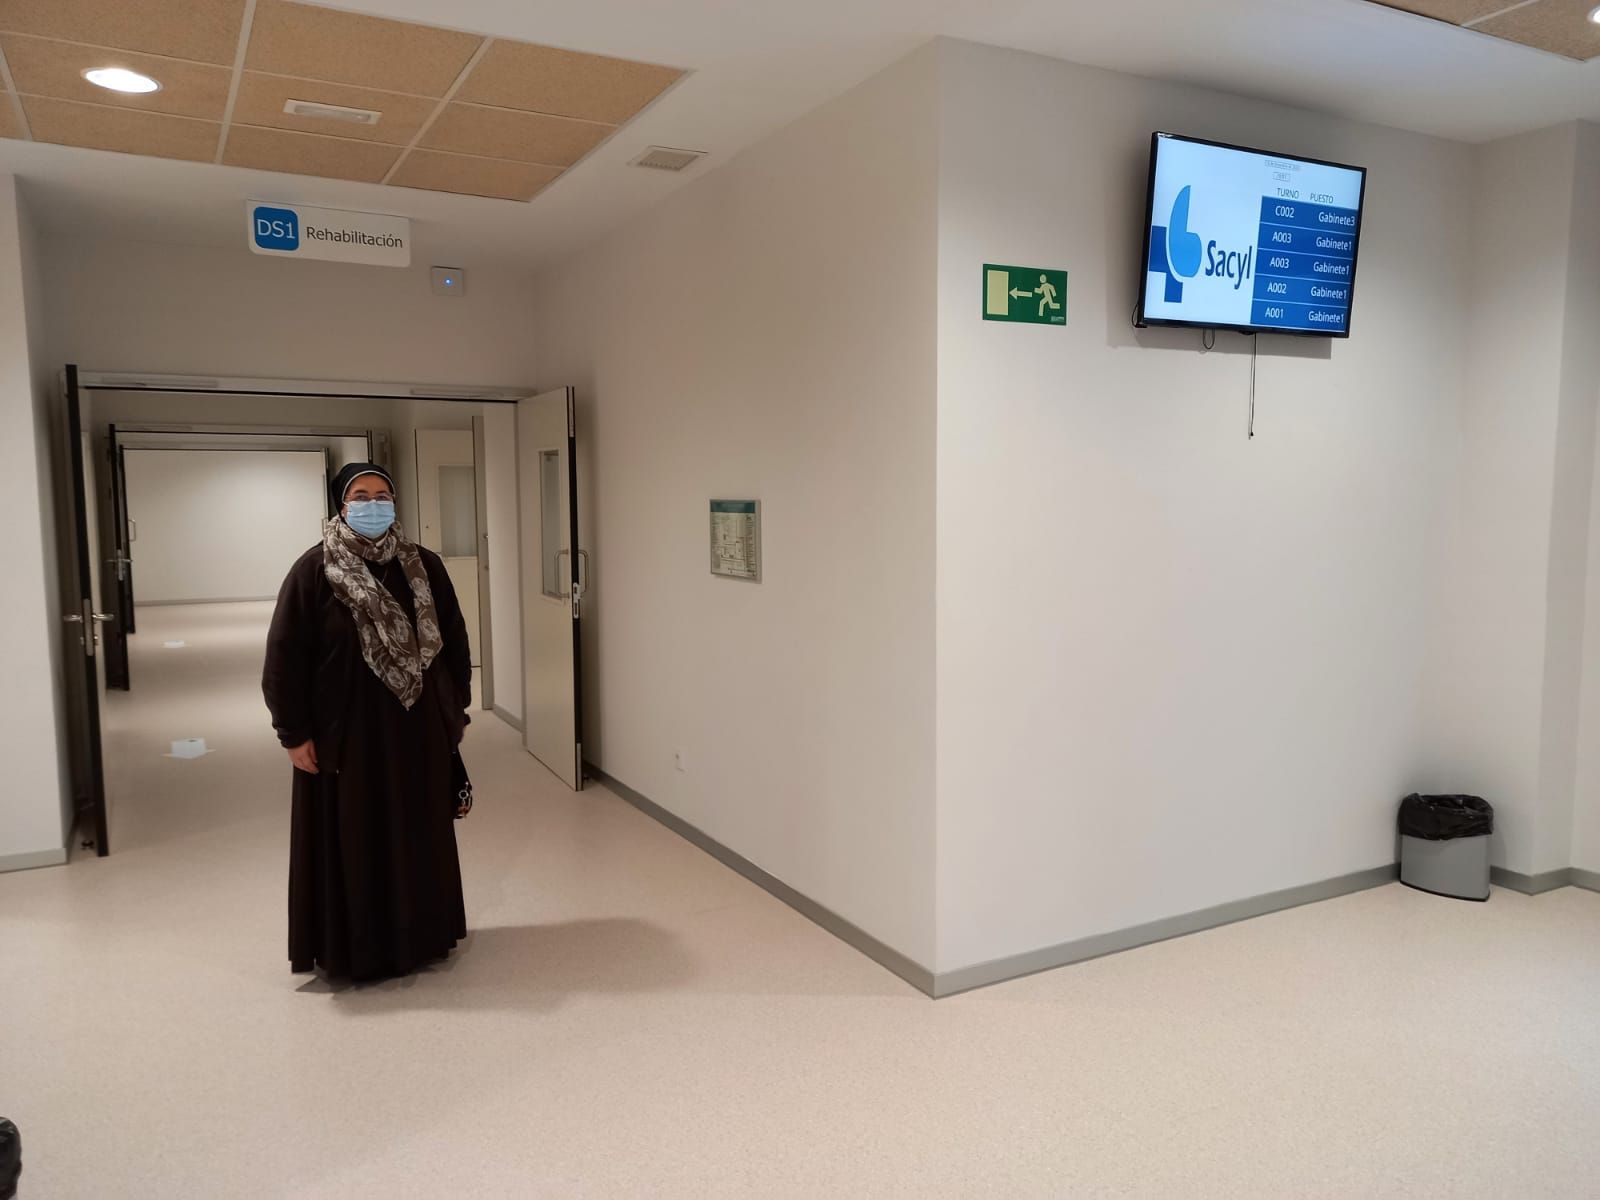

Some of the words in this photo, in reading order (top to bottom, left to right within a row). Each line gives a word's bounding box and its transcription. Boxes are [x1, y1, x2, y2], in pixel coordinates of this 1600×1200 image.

[1277, 187, 1300, 199] TURNO
[1310, 192, 1334, 204] PUESTO
[1275, 205, 1295, 218] C002
[1318, 211, 1355, 227] Gabinete3
[256, 218, 295, 239] DS1
[306, 226, 403, 249] Rehabilitación
[1271, 231, 1292, 244] A003
[1315, 236, 1352, 251] Gabinete1
[1205, 239, 1253, 290] Sacyl
[1269, 257, 1290, 269] A003
[1313, 261, 1350, 276] Gabinete1
[1267, 282, 1287, 294] A002
[1310, 286, 1347, 300] Gabinete1
[1264, 306, 1284, 319] A001
[1308, 310, 1345, 324] Gabinete1
